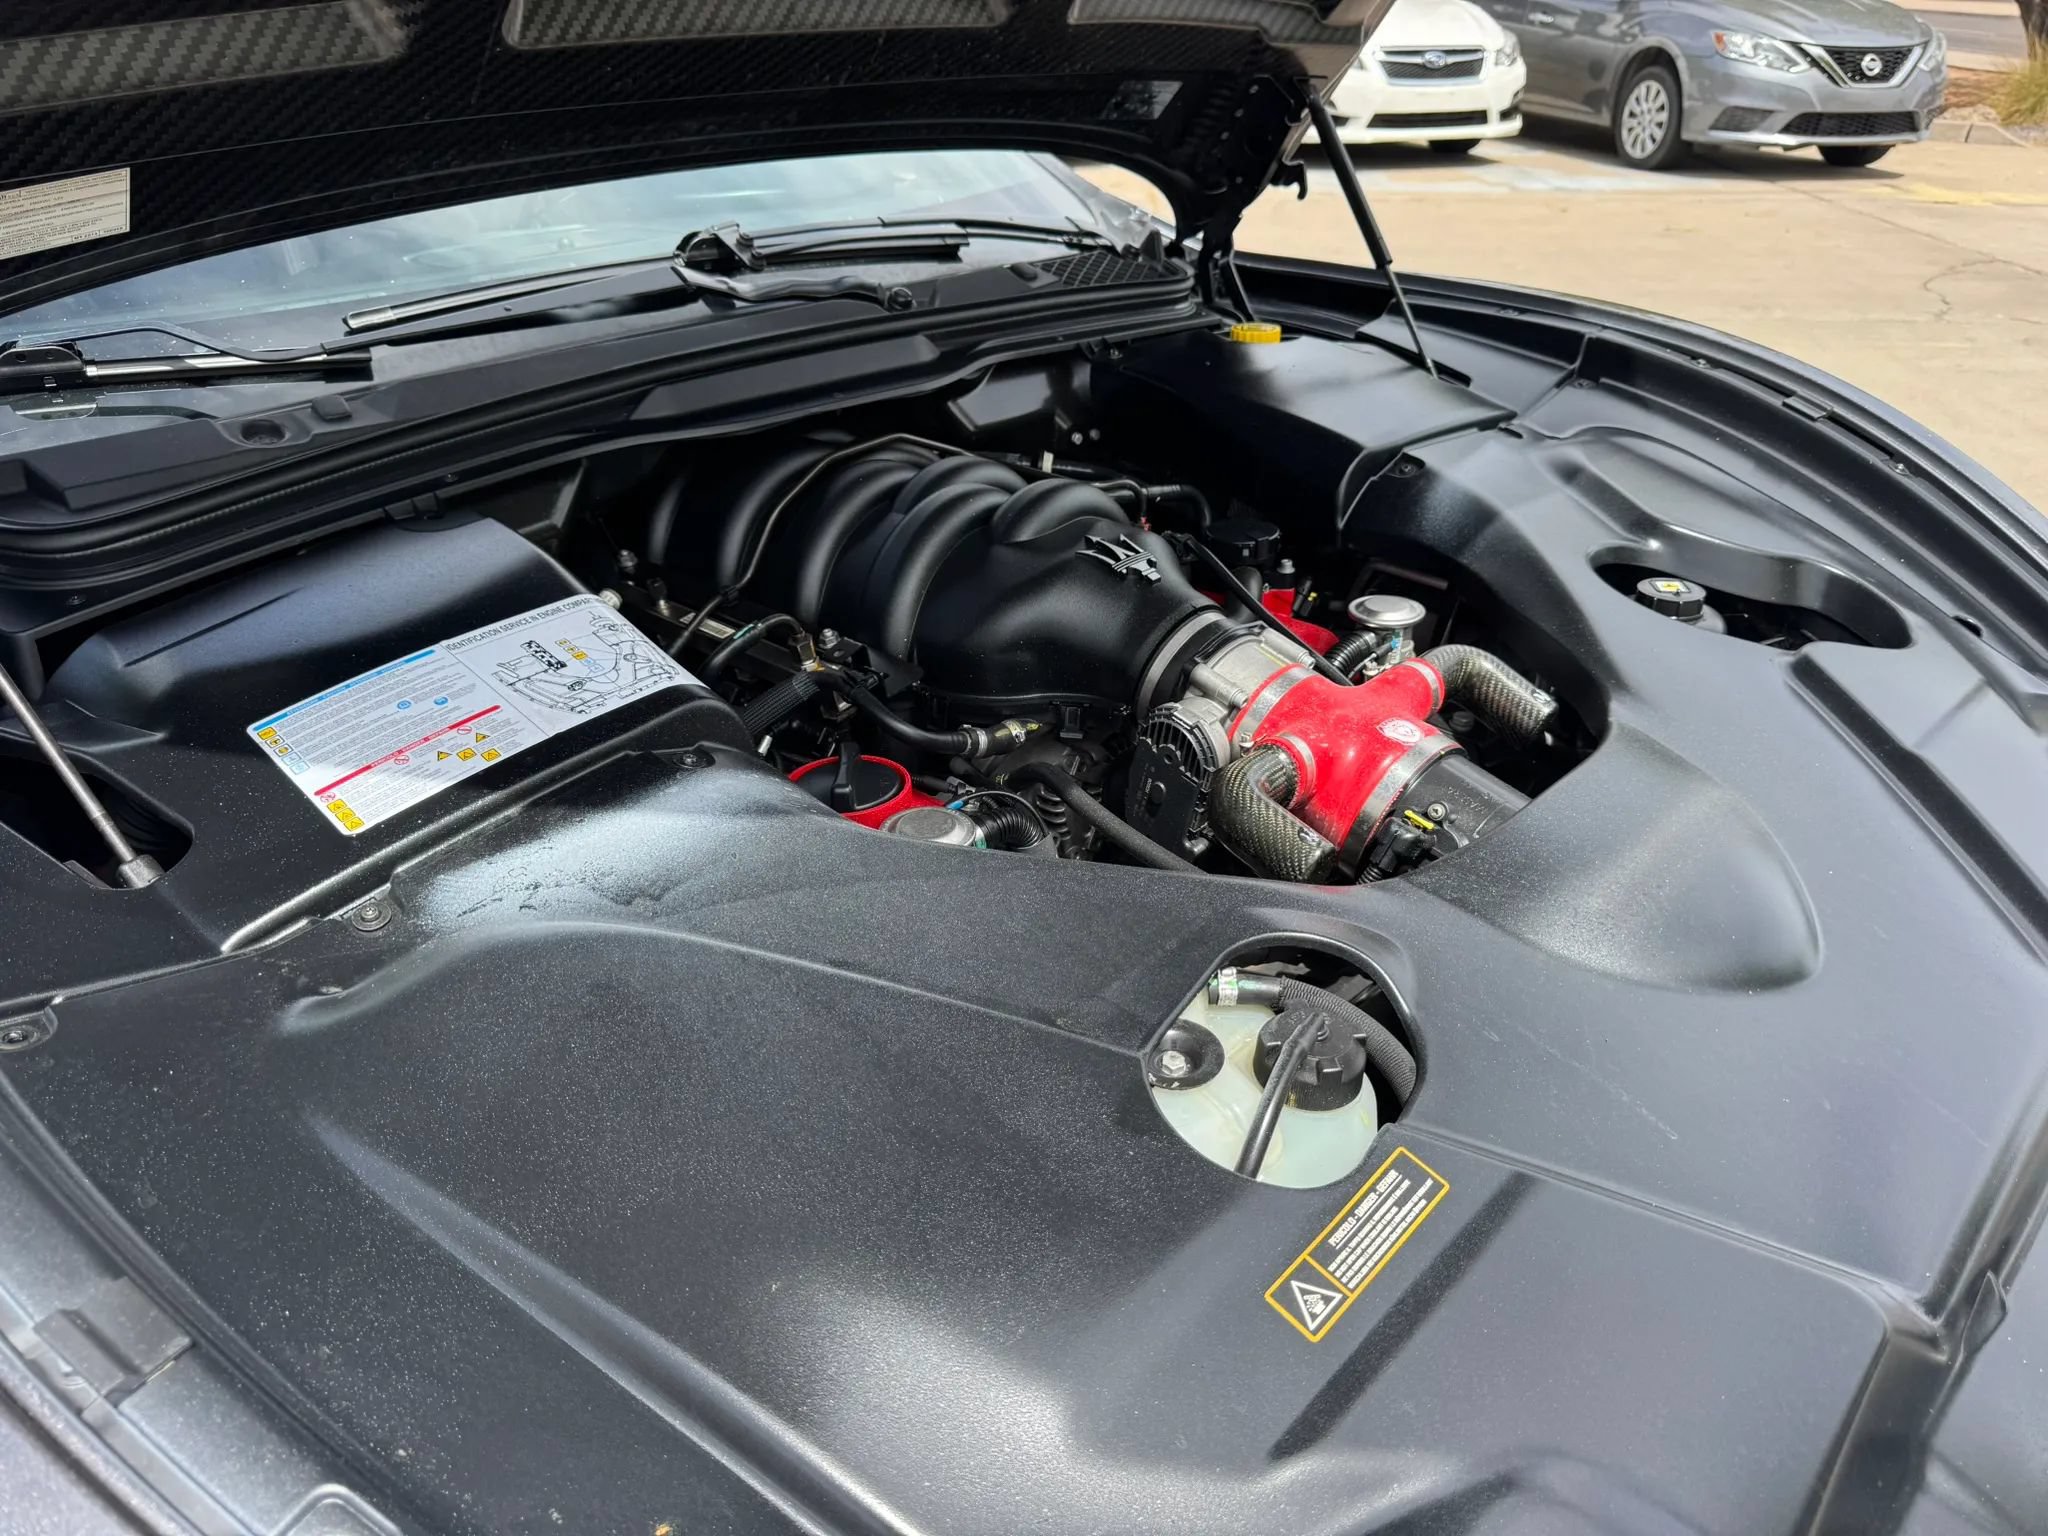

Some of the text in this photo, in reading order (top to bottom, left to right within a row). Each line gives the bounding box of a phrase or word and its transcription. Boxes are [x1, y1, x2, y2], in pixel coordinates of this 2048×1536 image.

[446, 627, 501, 651] IDENTIFICATION
[500, 618, 531, 633] SERVICE
[536, 606, 563, 620] ENGINE
[1328, 1217, 1357, 1247] PERICOLO
[1355, 1192, 1379, 1217] DANGER
